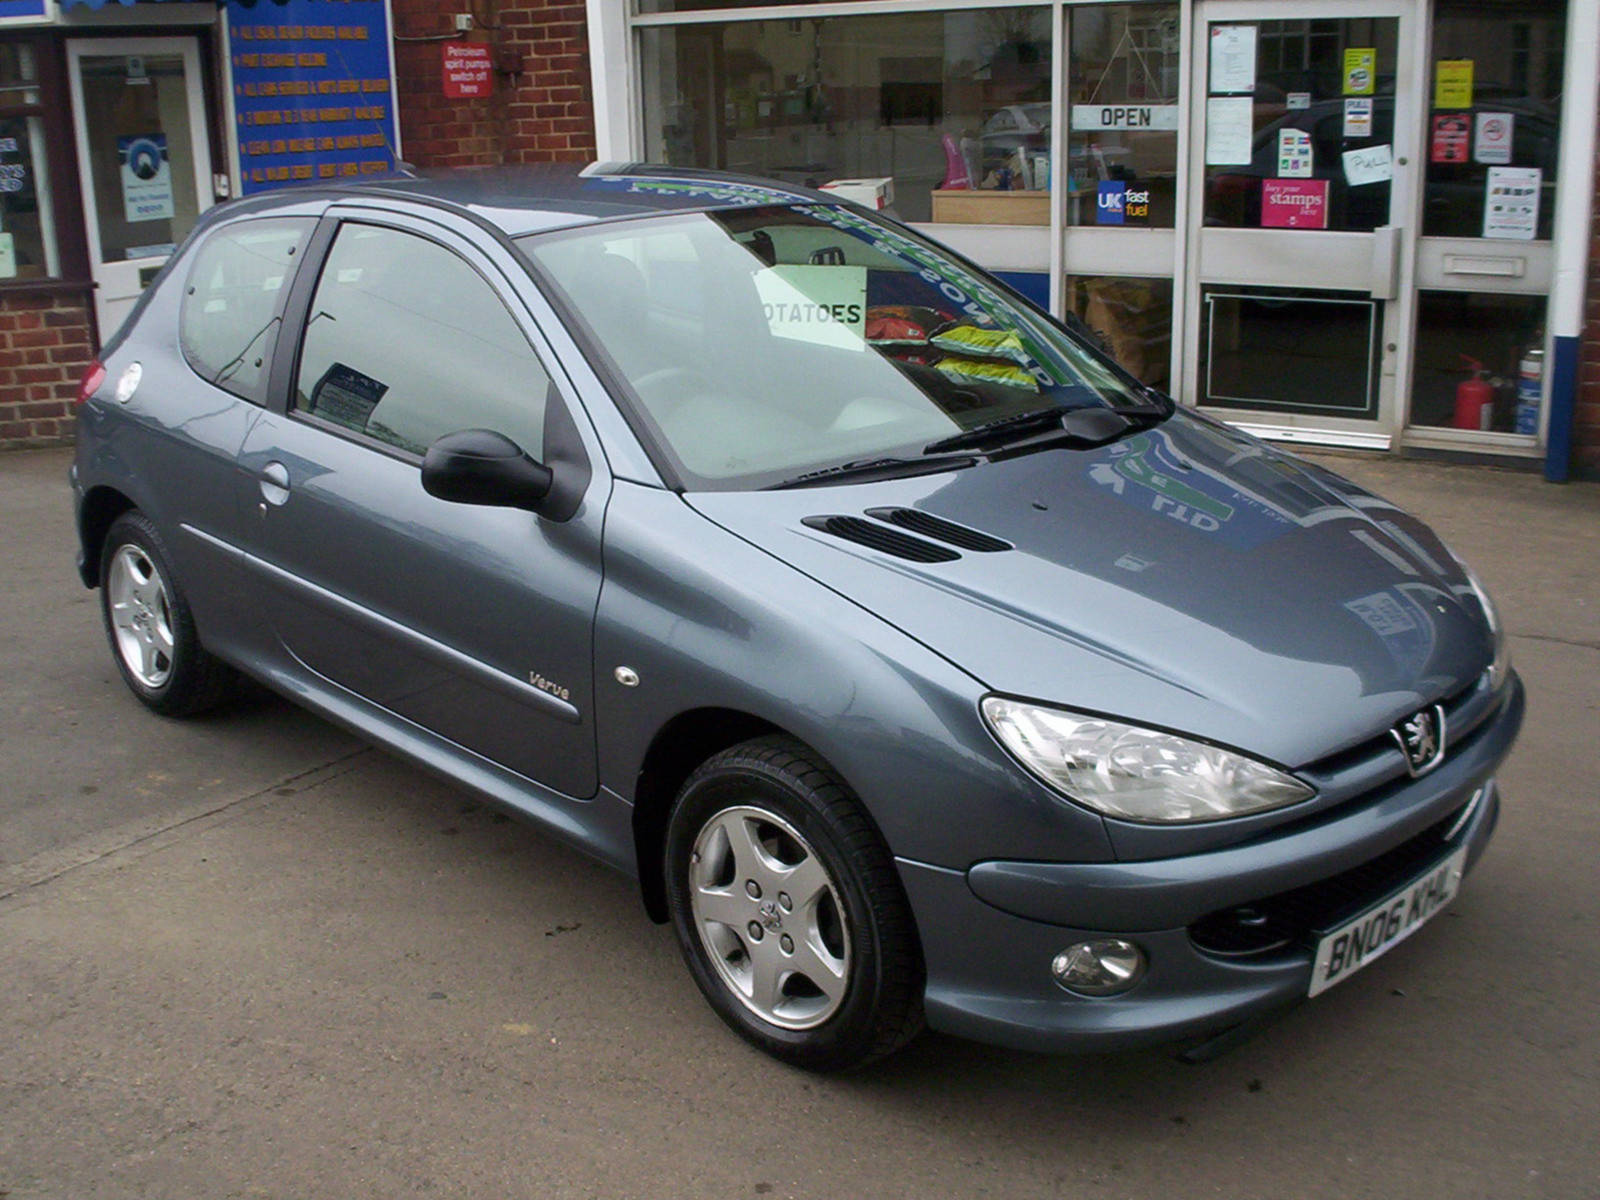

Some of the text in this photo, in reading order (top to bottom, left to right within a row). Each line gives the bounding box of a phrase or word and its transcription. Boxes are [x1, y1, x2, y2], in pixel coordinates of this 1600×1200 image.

[1101, 107, 1151, 126] OPEN
[1124, 188, 1149, 203] fast
[1281, 185, 1300, 194] your
[1098, 193, 1122, 208] UK
[1269, 191, 1322, 210] stamps
[1125, 204, 1148, 217] fuel
[529, 671, 569, 700] Verve
